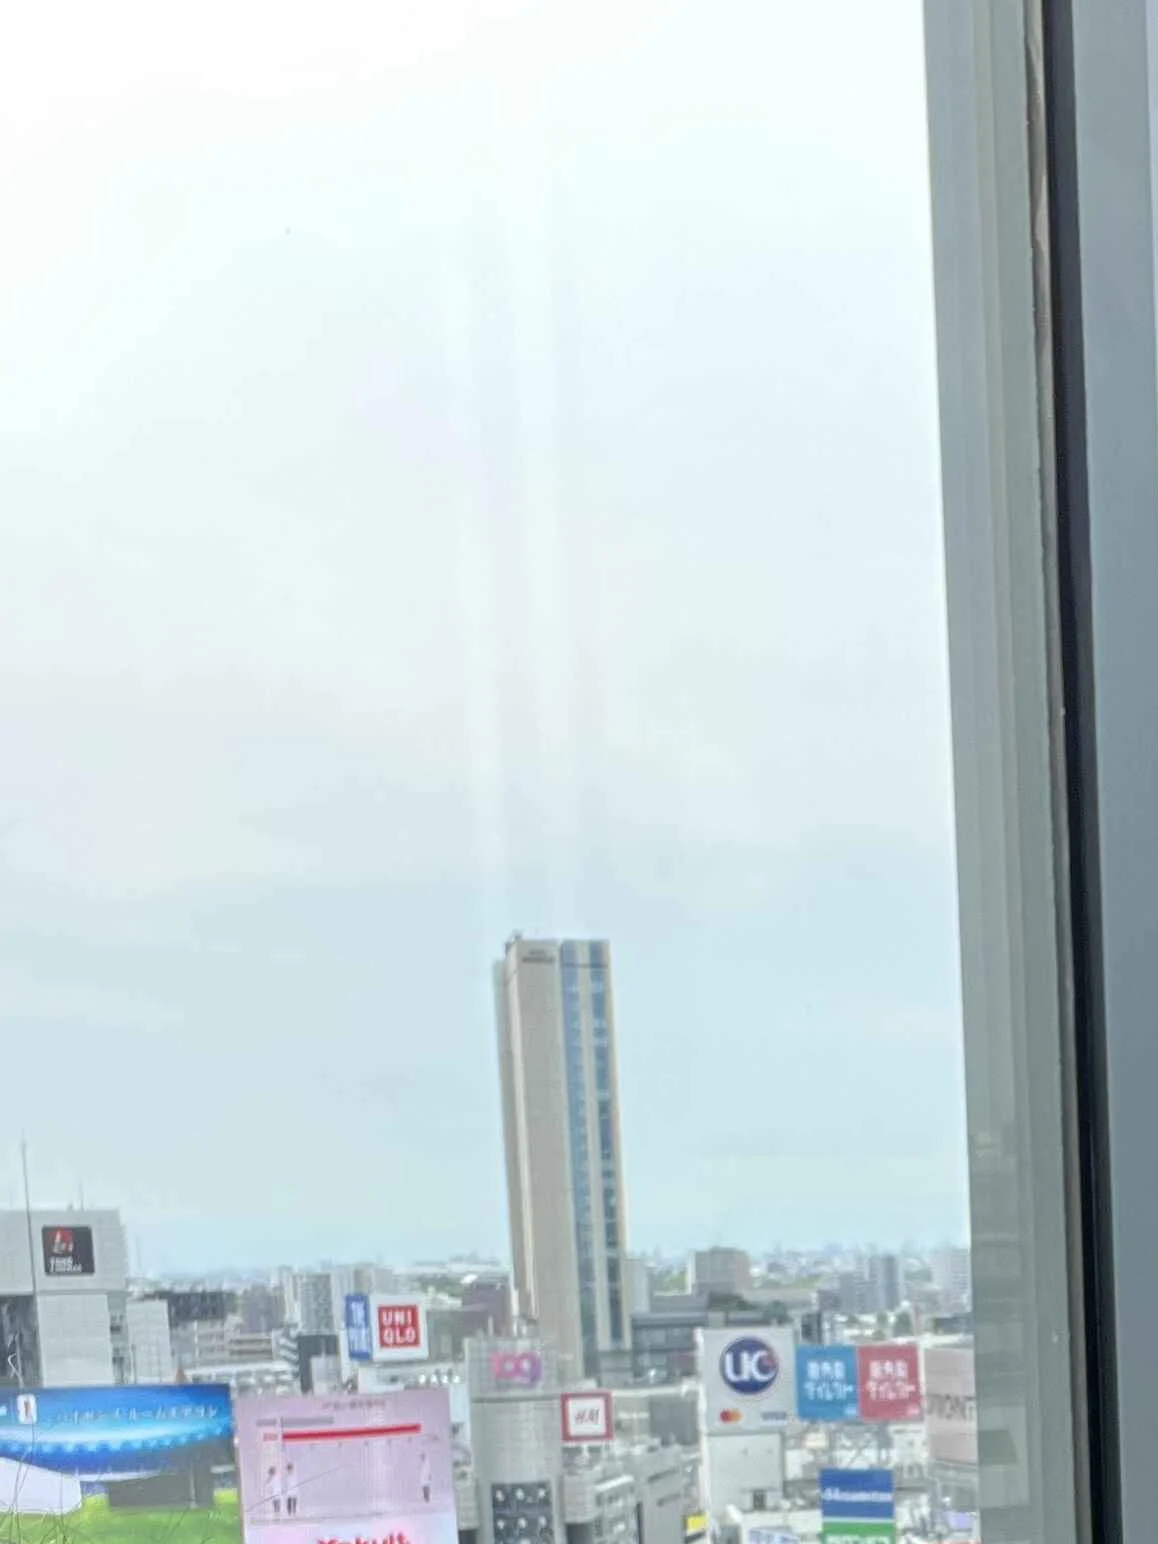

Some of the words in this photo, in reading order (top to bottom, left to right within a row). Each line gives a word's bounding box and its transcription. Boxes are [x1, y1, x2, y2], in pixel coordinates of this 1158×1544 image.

[382, 1308, 413, 1327] UNI
[383, 1326, 417, 1346] QLO
[724, 1350, 778, 1383] UC
